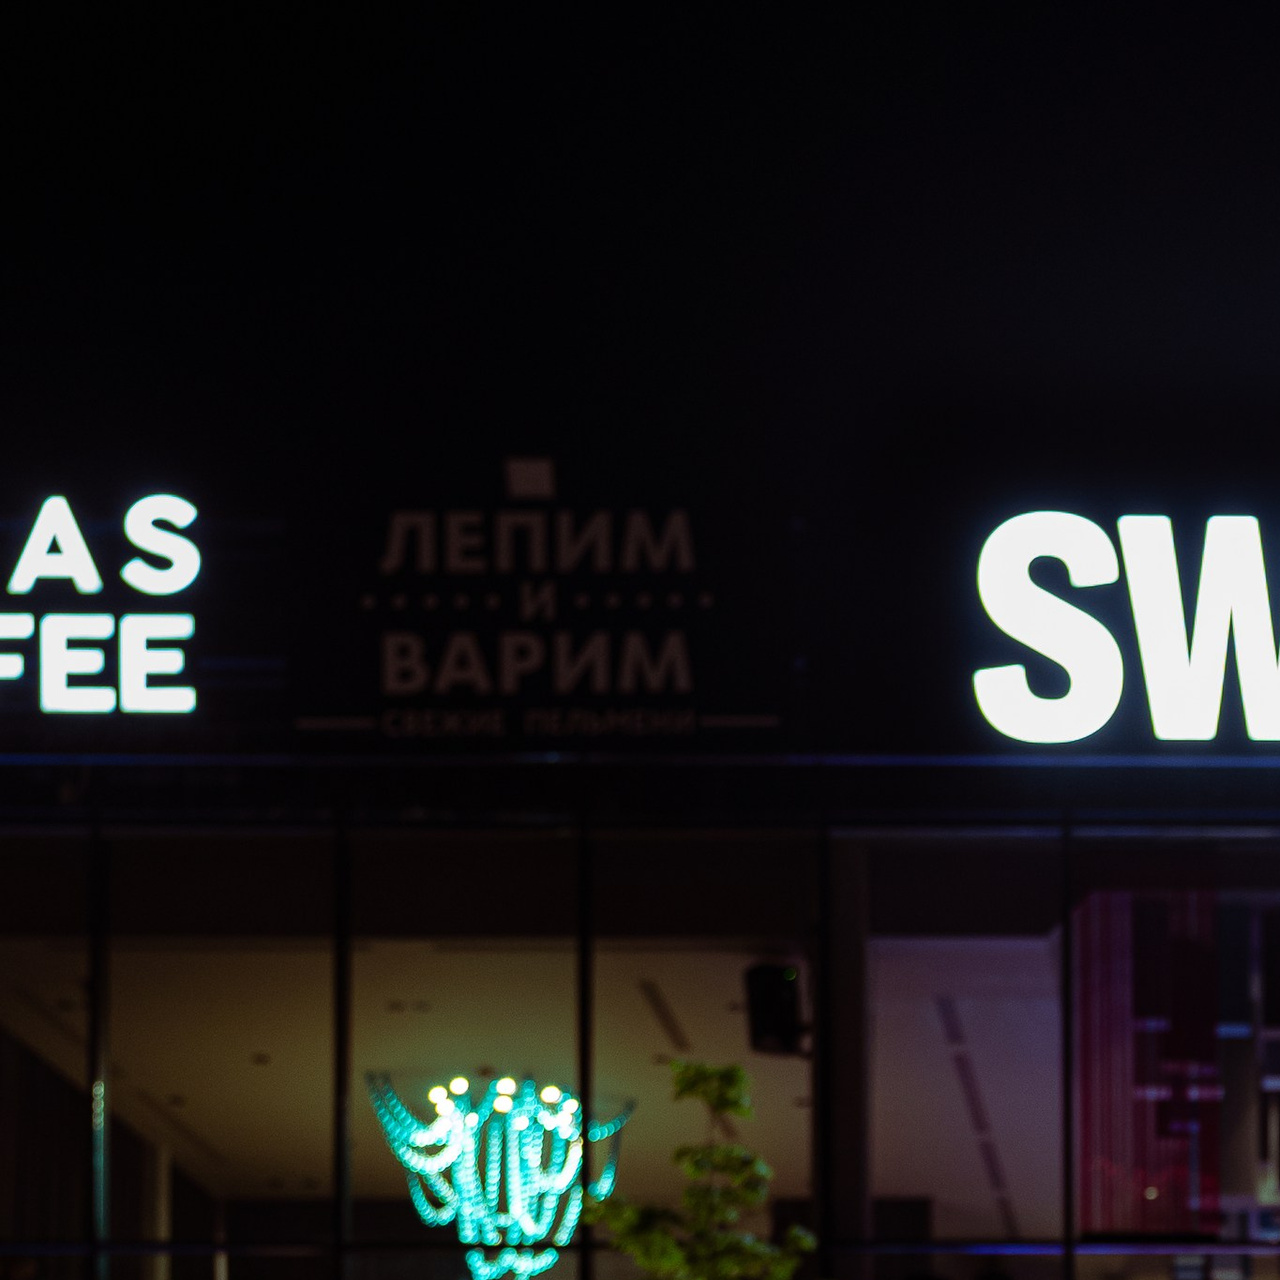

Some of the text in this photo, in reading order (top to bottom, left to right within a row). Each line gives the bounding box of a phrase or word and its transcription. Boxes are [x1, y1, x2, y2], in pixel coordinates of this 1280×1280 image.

[7, 494, 202, 595] AS
[378, 508, 696, 575] ЛЕПИМ
[518, 579, 559, 623] И
[380, 629, 694, 696] ВАРИМ
